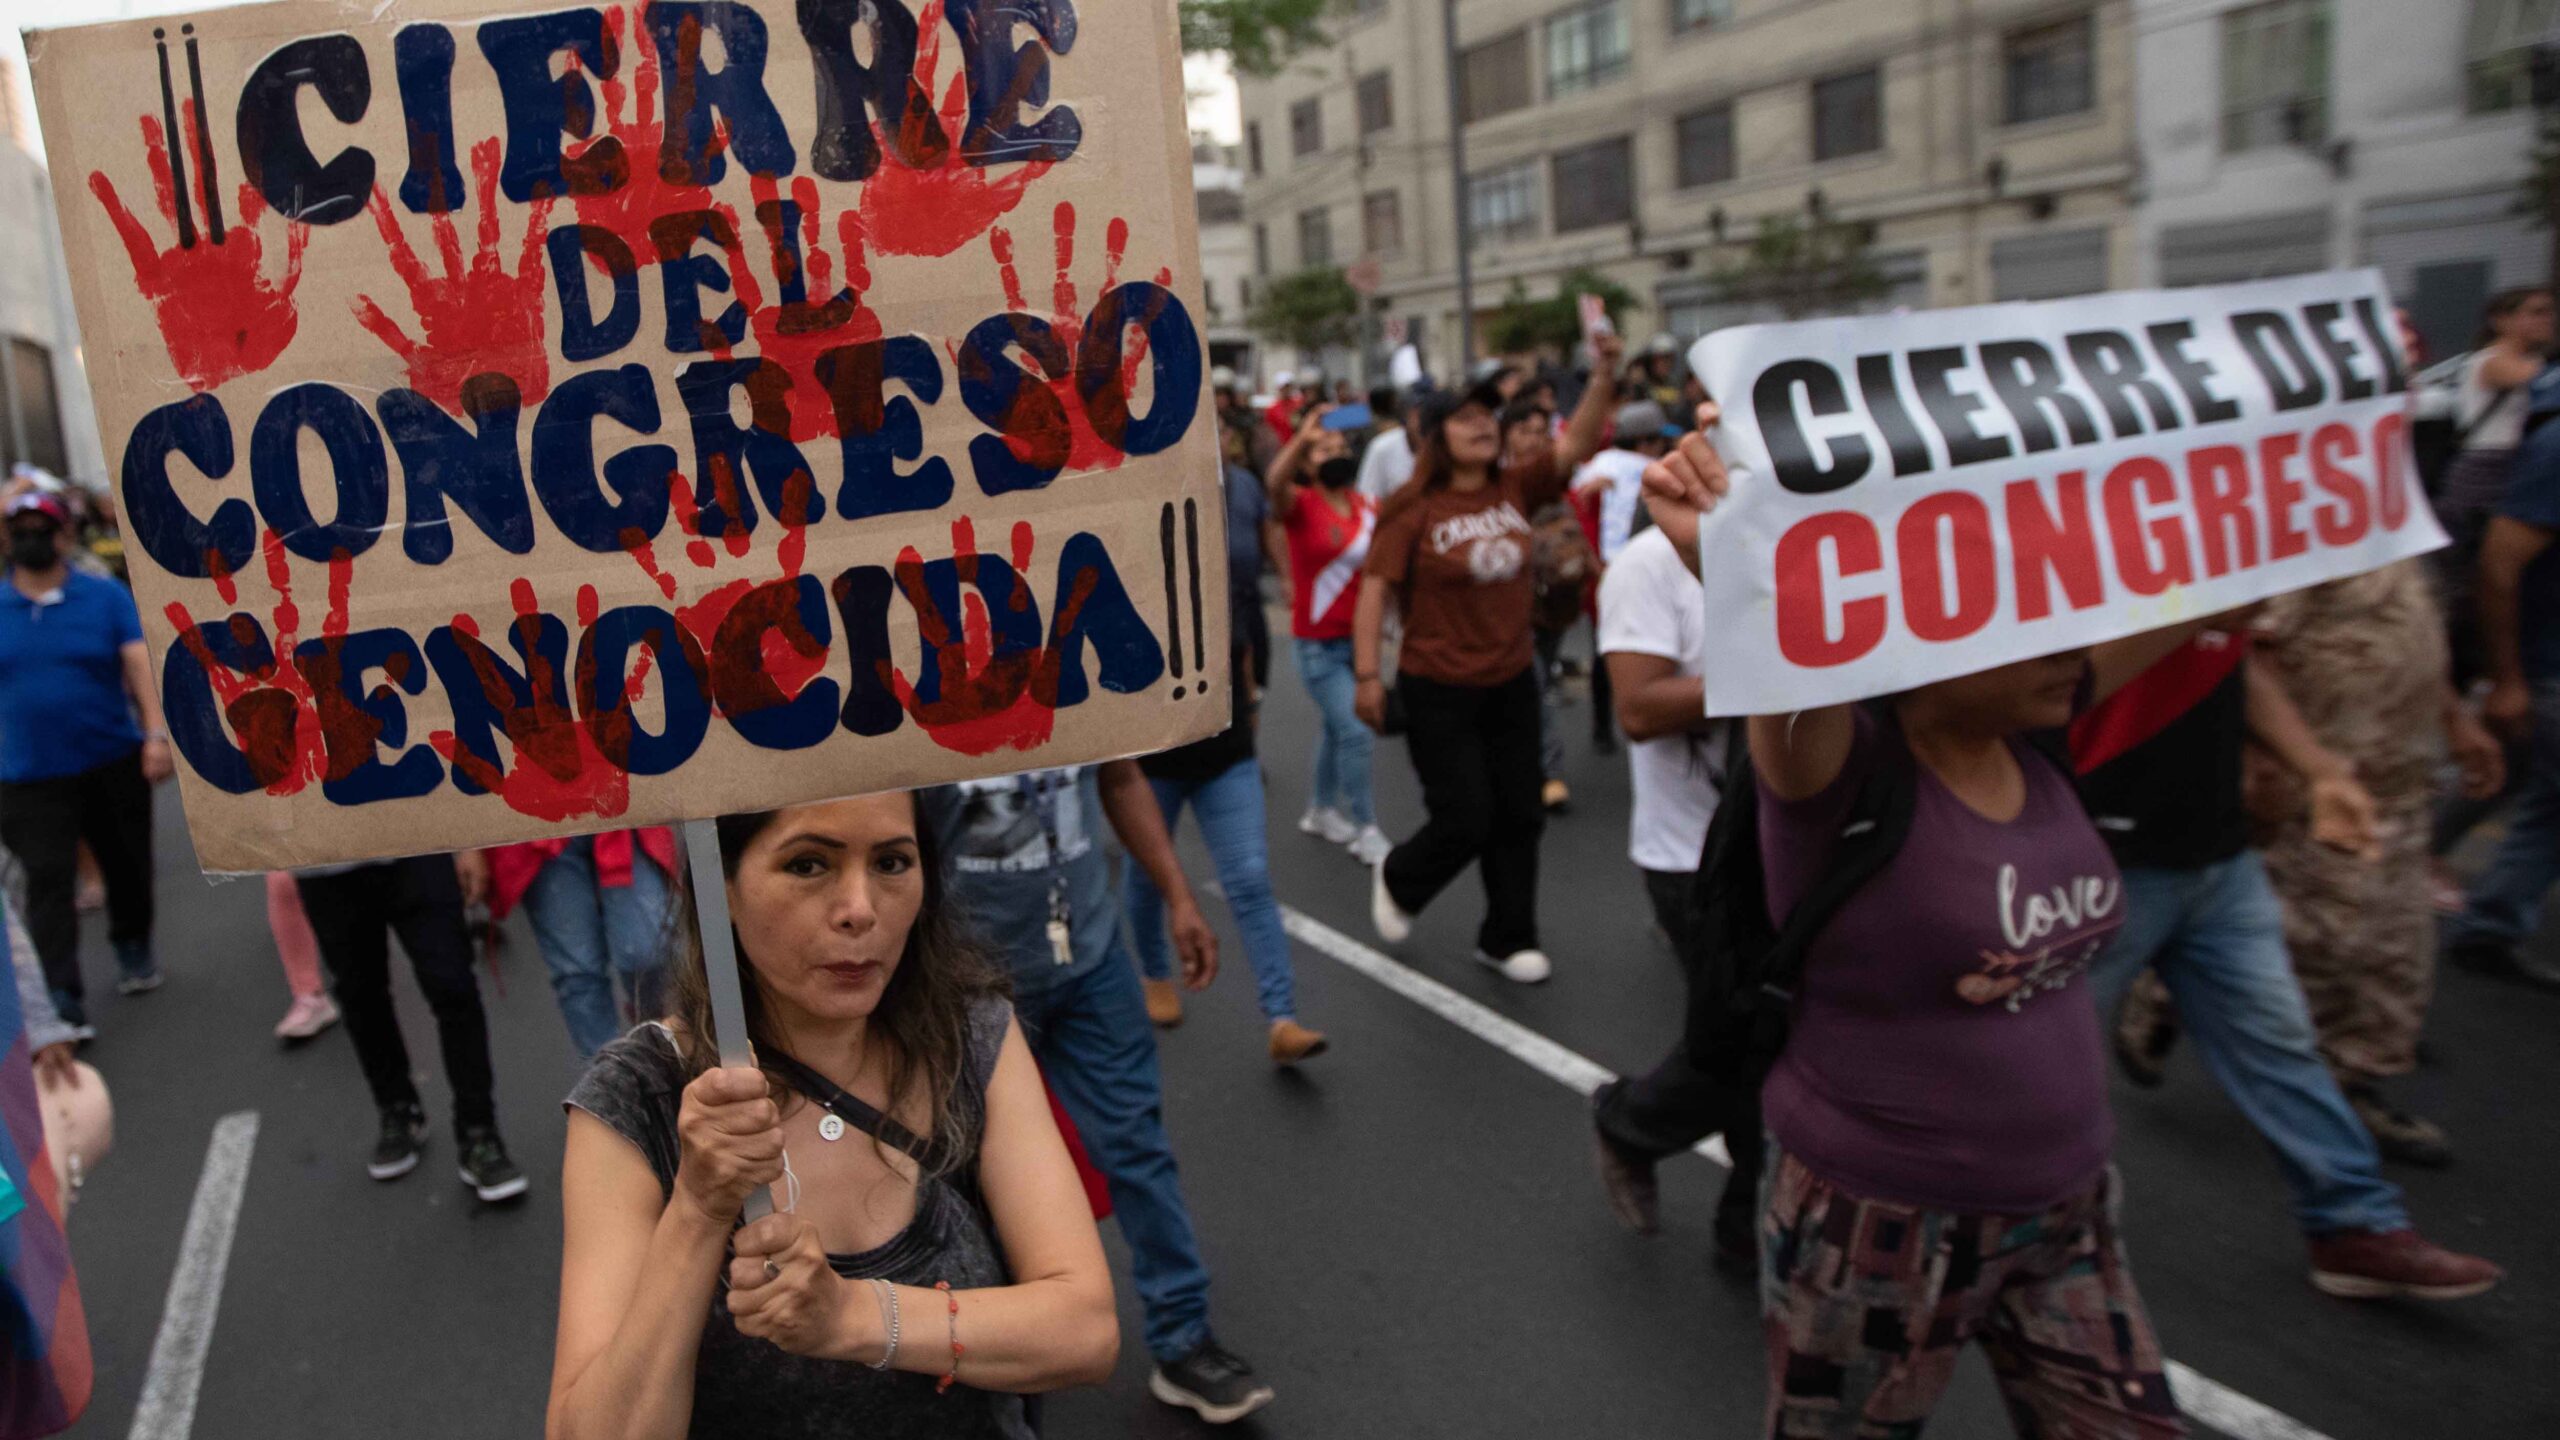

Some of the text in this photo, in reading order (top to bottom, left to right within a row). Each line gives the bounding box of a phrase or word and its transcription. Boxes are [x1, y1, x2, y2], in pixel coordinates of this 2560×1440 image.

[547, 199, 861, 362] DEL
[121, 281, 1202, 578] CONGRESO
[1752, 320, 2241, 494] CIERRE
[1774, 411, 2411, 668] CONGRESO
[1997, 863, 2119, 948] love
